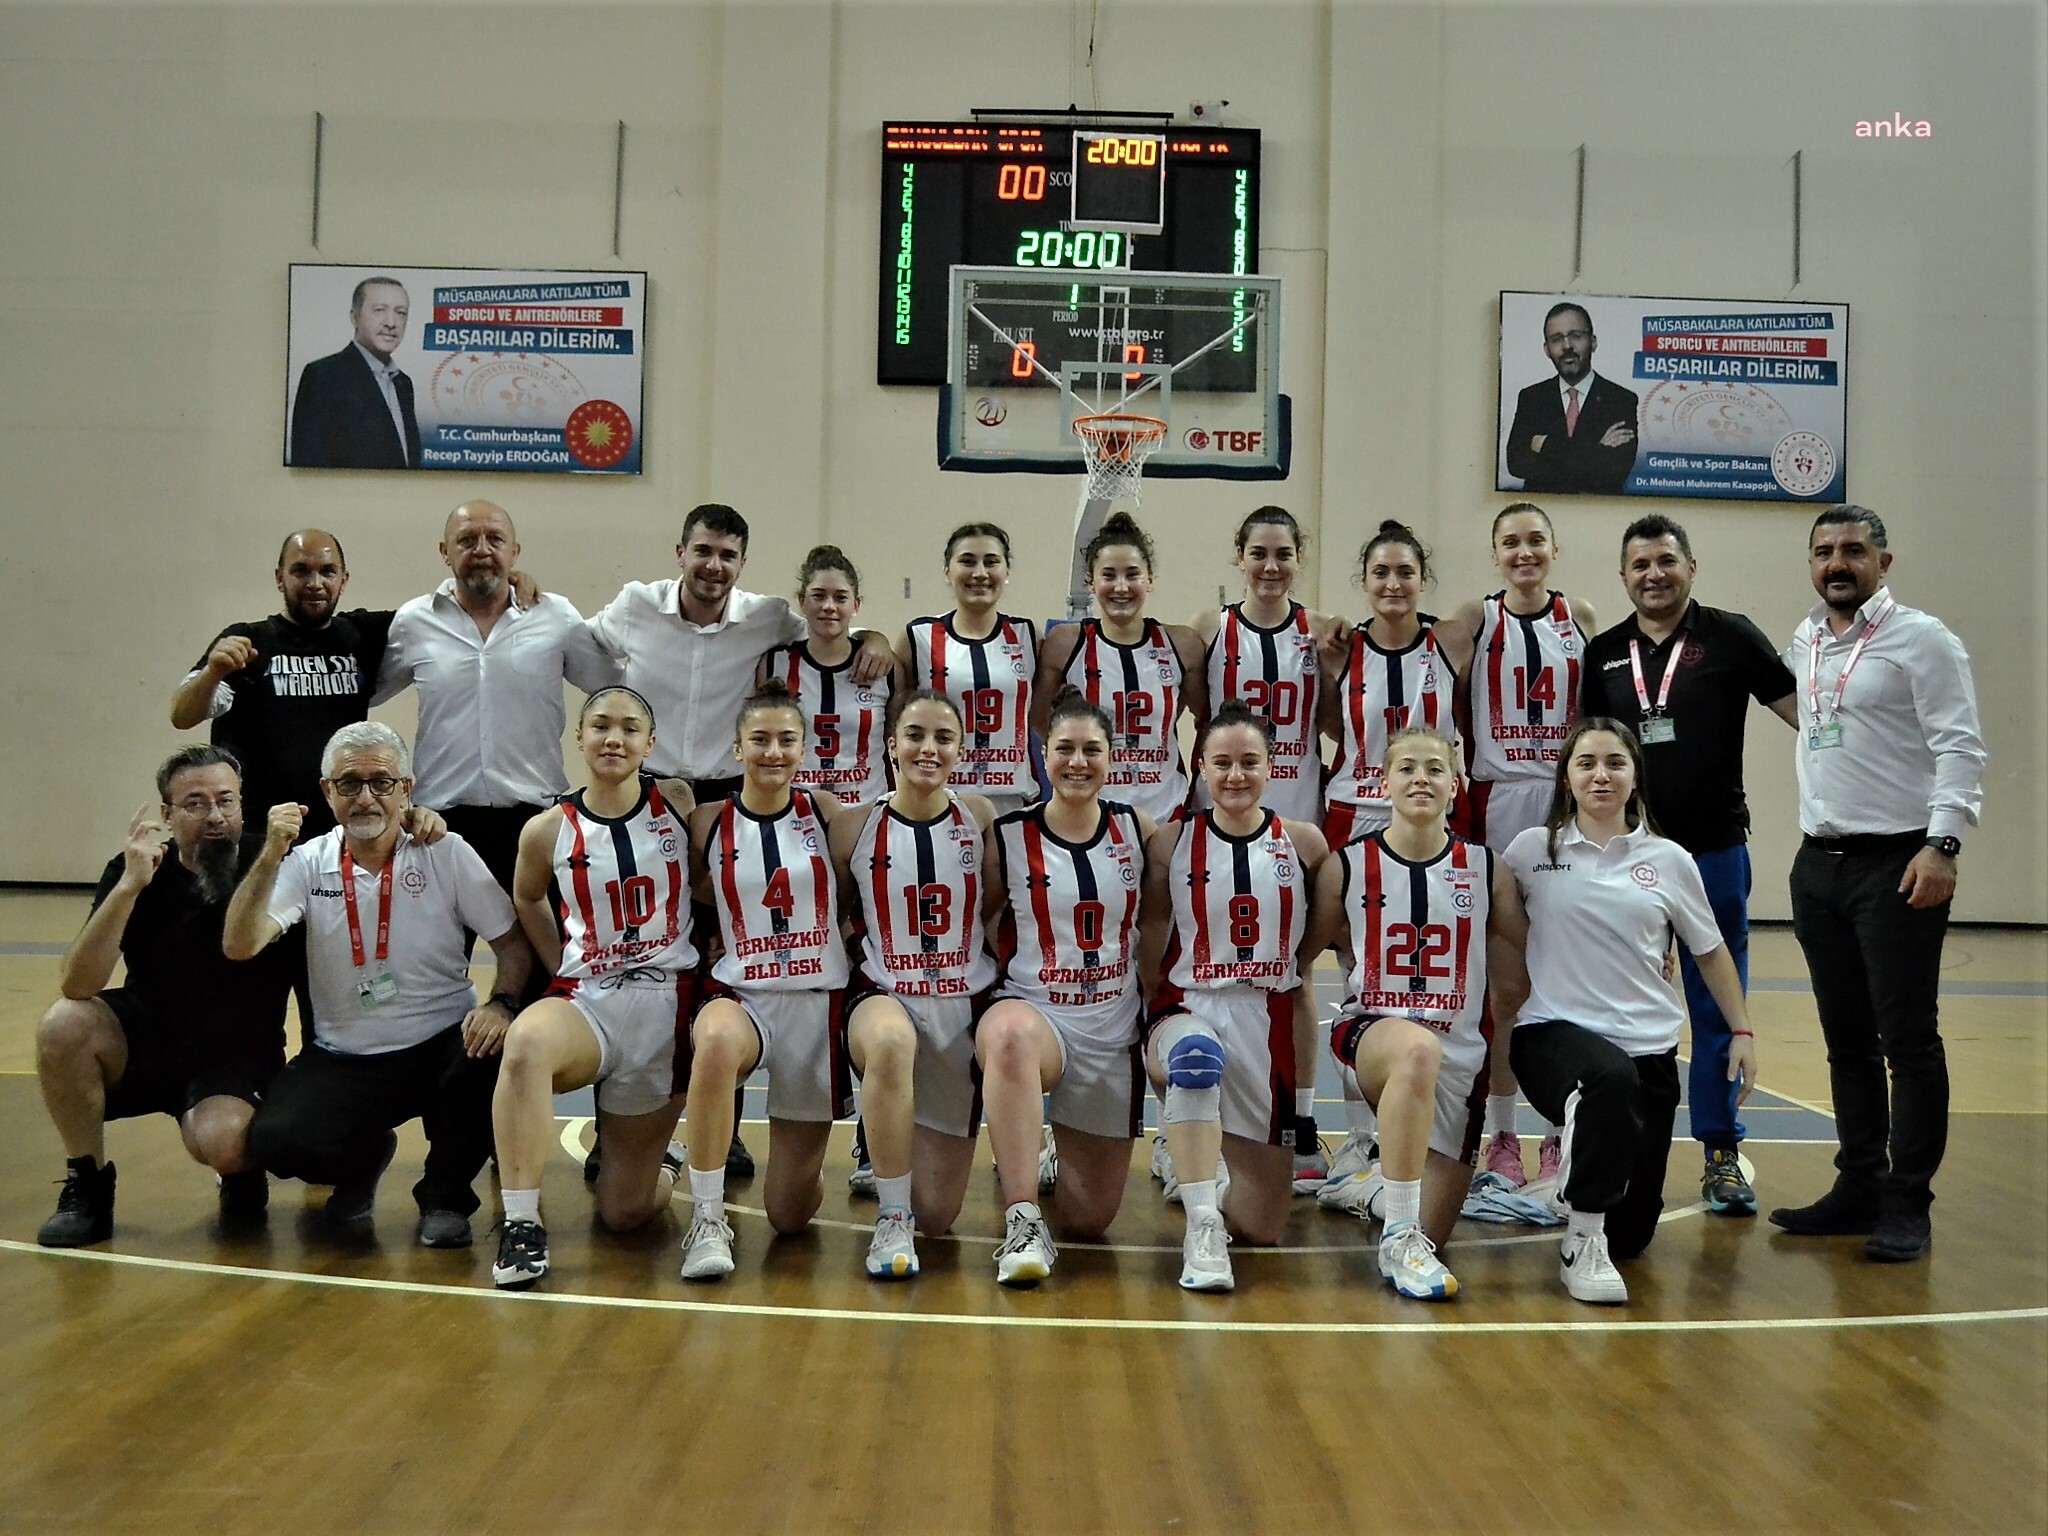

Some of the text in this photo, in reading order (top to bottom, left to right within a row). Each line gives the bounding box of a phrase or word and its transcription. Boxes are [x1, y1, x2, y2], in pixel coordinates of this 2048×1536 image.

[1088, 138, 1157, 166] 20:00
[998, 165, 1046, 200] 00
[1016, 231, 1120, 267] 20:00
[438, 284, 622, 303] MÜSABAKALARA KATILAN TÜM
[449, 307, 603, 322] SPORCU VE ANTRENÖRLERE
[1053, 311, 1078, 322] PERIOD
[1647, 314, 1826, 332] MÜSABAKALARA KATILAN TÜM
[435, 328, 620, 350] BAŞARILAR DİLERİM.
[1657, 337, 1807, 353] SPORCU VE ANTRENÖRLERE
[1012, 342, 1036, 377] 0
[1644, 357, 1825, 380] BAŞARILAR DİLERİM.
[439, 429, 561, 444] T.C. Cumhurbaşkanı
[1212, 430, 1262, 452] TBF
[424, 449, 569, 464] Recep Tayyip ERDOĞAN
[1649, 457, 1768, 471] Gençlik ve Spor Bakanı
[1636, 477, 1777, 492] Dr. Mehmet Muharrem Kasapoğlu
[266, 654, 328, 674] OLDEN
[273, 672, 359, 696] WARRIORS
[1513, 666, 1556, 710] 14
[961, 689, 1004, 734] 19
[1113, 691, 1154, 735] 12
[1243, 680, 1298, 726] 20
[814, 714, 841, 758] 5
[1491, 722, 1571, 743] ÇERKEZKÖ
[961, 745, 1026, 763] KEZKÖY
[1505, 748, 1561, 761] BLD GS
[792, 766, 871, 784] ERKEZKÖY
[947, 771, 1014, 785] BLD GSK
[1138, 771, 1161, 784] GSK
[1270, 765, 1298, 779] GSK
[1532, 862, 1571, 873] uhlsport
[605, 875, 656, 932] 10
[761, 867, 795, 918] 4
[903, 883, 952, 936] 13
[1228, 894, 1260, 947] 8
[1073, 901, 1105, 951] 0
[735, 926, 830, 961] ÇERKEZKÖY
[1386, 923, 1451, 977] 22
[744, 958, 823, 981] BLD GSK
[884, 947, 971, 972] ÇERKEZKÖY
[1038, 958, 1129, 985] ÇERKEZKÖY
[936, 977, 970, 994] GSK
[1049, 991, 1086, 1005] BLD
[1361, 989, 1467, 1011] ÇERKEZKÖY
